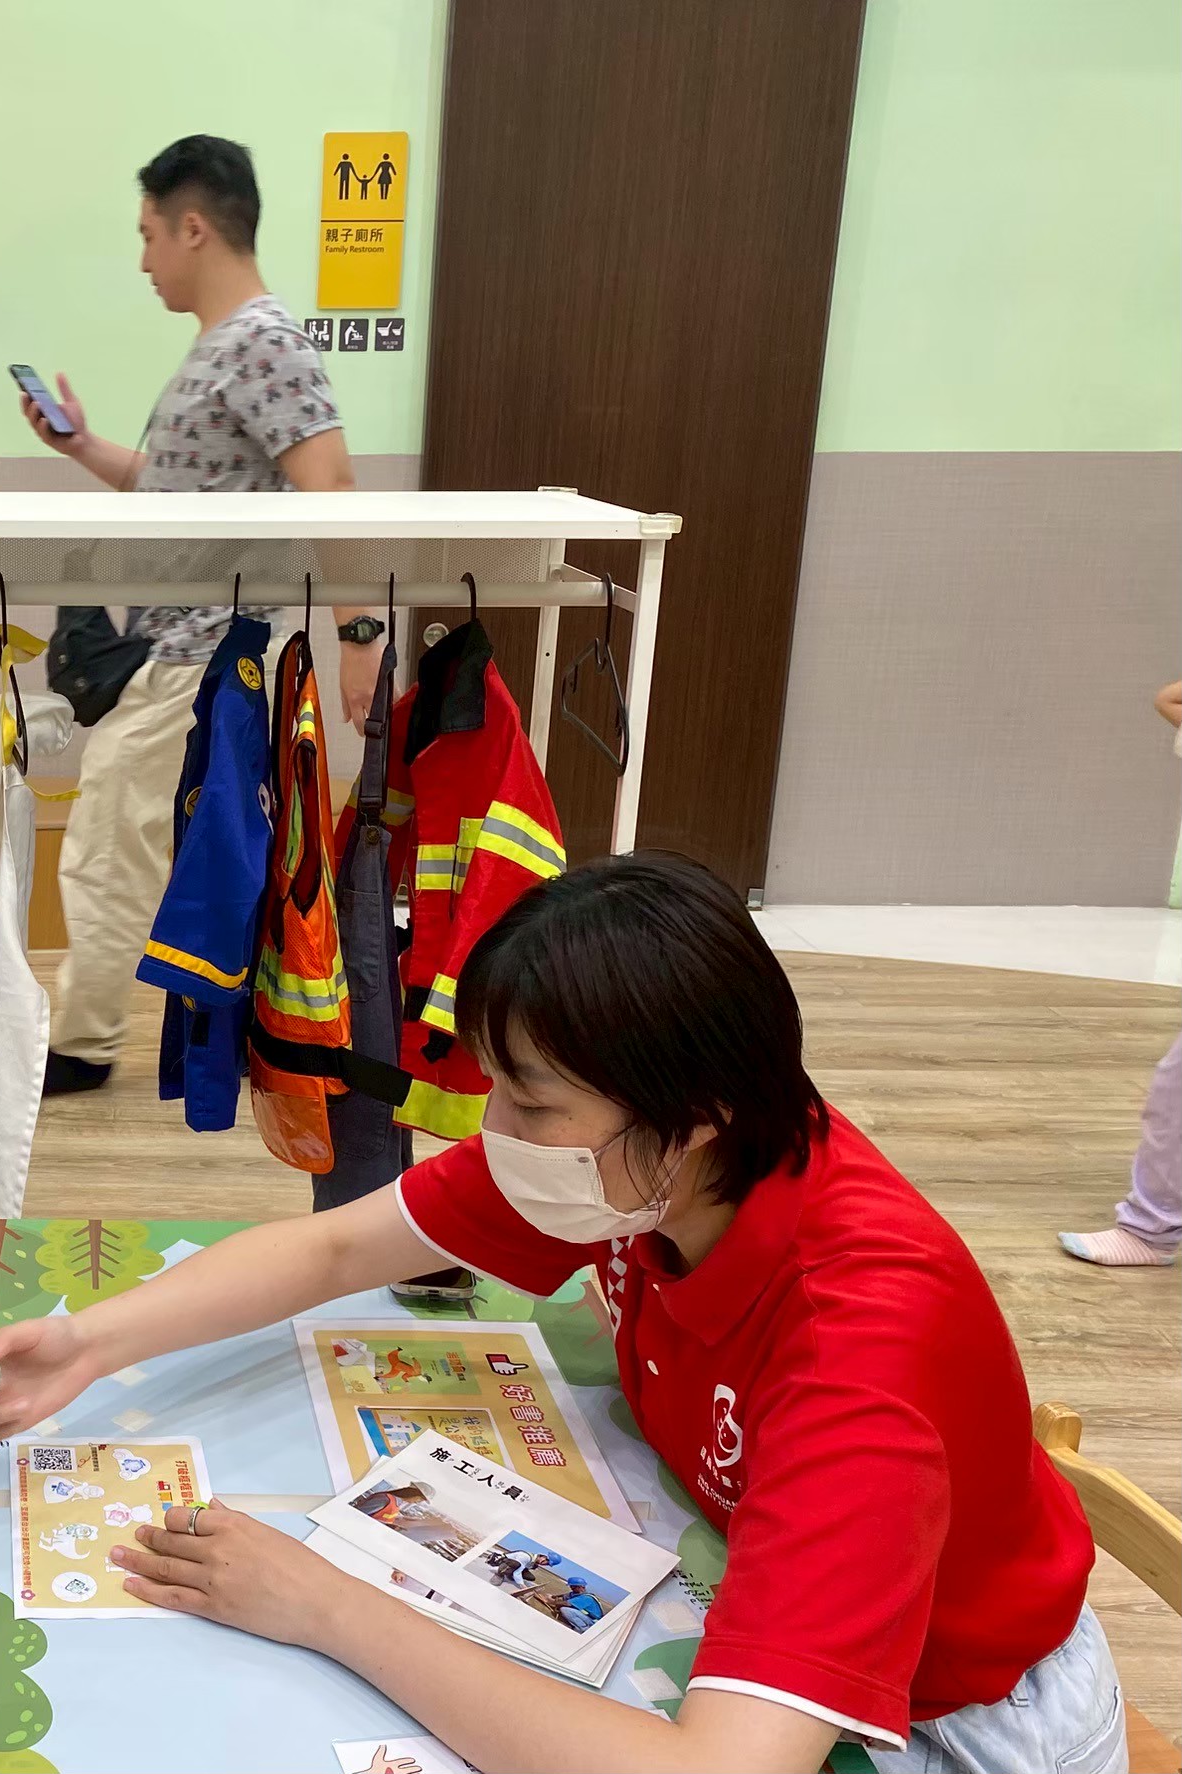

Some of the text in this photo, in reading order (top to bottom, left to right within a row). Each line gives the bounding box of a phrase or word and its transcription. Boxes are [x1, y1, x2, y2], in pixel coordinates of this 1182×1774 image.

[325, 228, 384, 243] 親子廁所
[325, 245, 385, 255] Family Restroom
[500, 1384, 566, 1466] 好書推薦
[429, 1447, 524, 1501] 施工人員
